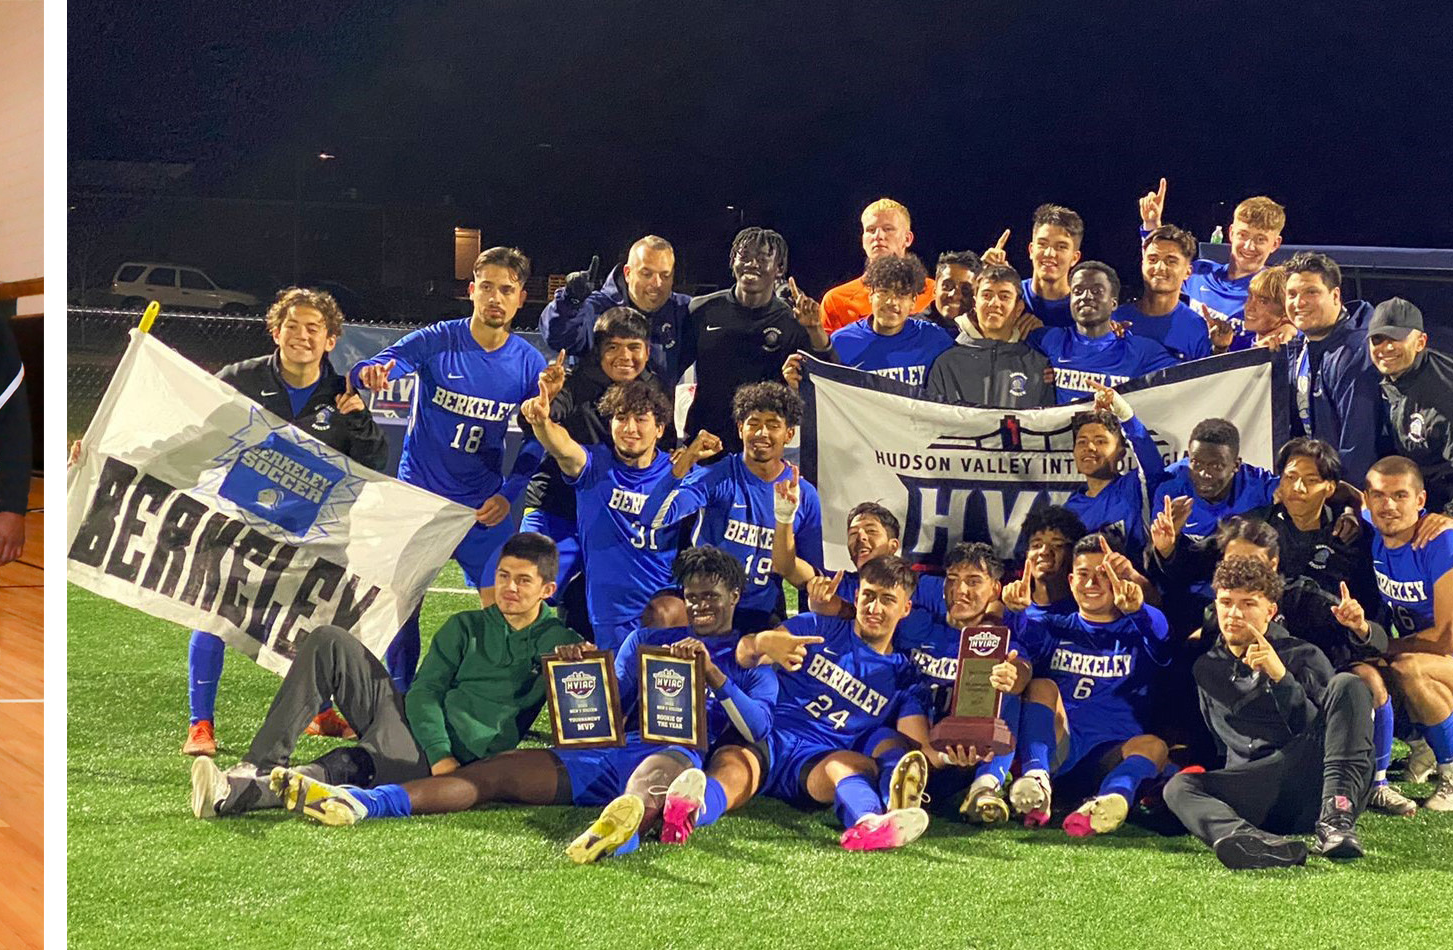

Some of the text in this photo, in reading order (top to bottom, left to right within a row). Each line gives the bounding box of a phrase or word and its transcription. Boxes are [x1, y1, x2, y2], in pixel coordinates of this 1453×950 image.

[432, 386, 516, 422] BERKELEY
[450, 423, 484, 453] 18
[876, 449, 951, 472] HUDSON
[961, 456, 1033, 475] VALLEY
[240, 450, 323, 504] SOCCER
[630, 521, 658, 550] 31
[68, 456, 381, 661] BERKELEY
[745, 554, 773, 586] 19
[1050, 648, 1132, 678] BERKELEY
[567, 680, 595, 690] HVIAC
[657, 678, 682, 688] HVIAC
[807, 653, 889, 716] BERKELEY
[1072, 677, 1095, 700] 6
[656, 714, 676, 722] ROOKIE
[669, 722, 683, 730] YEAR
[804, 694, 850, 730] 24
[577, 723, 596, 731] MVP
